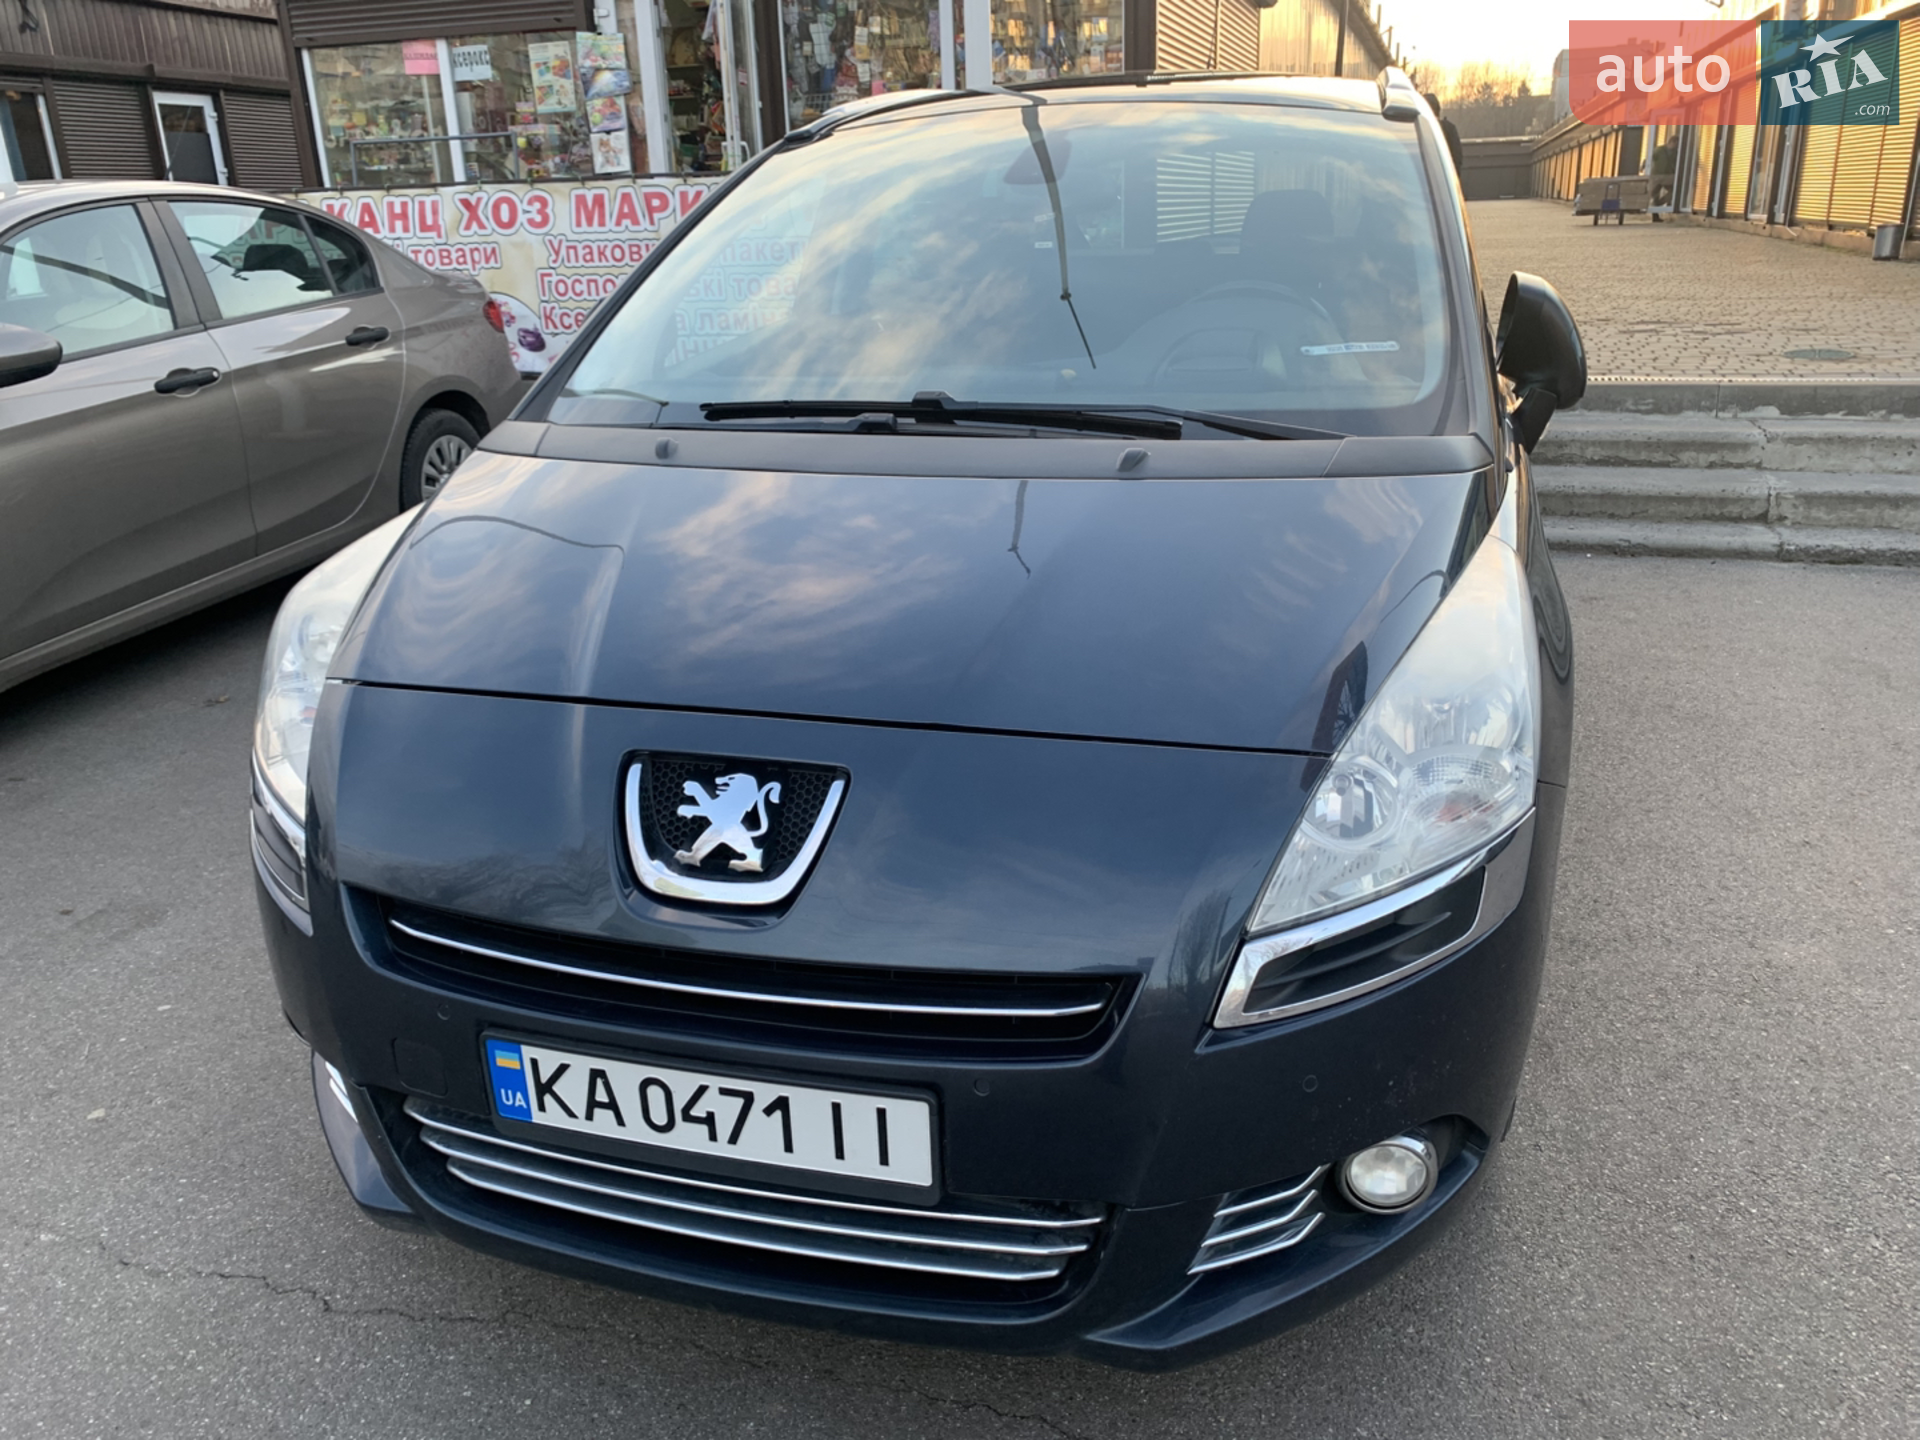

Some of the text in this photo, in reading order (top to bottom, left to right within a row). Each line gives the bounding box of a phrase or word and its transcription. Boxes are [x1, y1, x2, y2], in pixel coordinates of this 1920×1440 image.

[458, 194, 551, 232] ХОЗ
[410, 245, 500, 272] товари
[500, 1087, 528, 1110] UA
